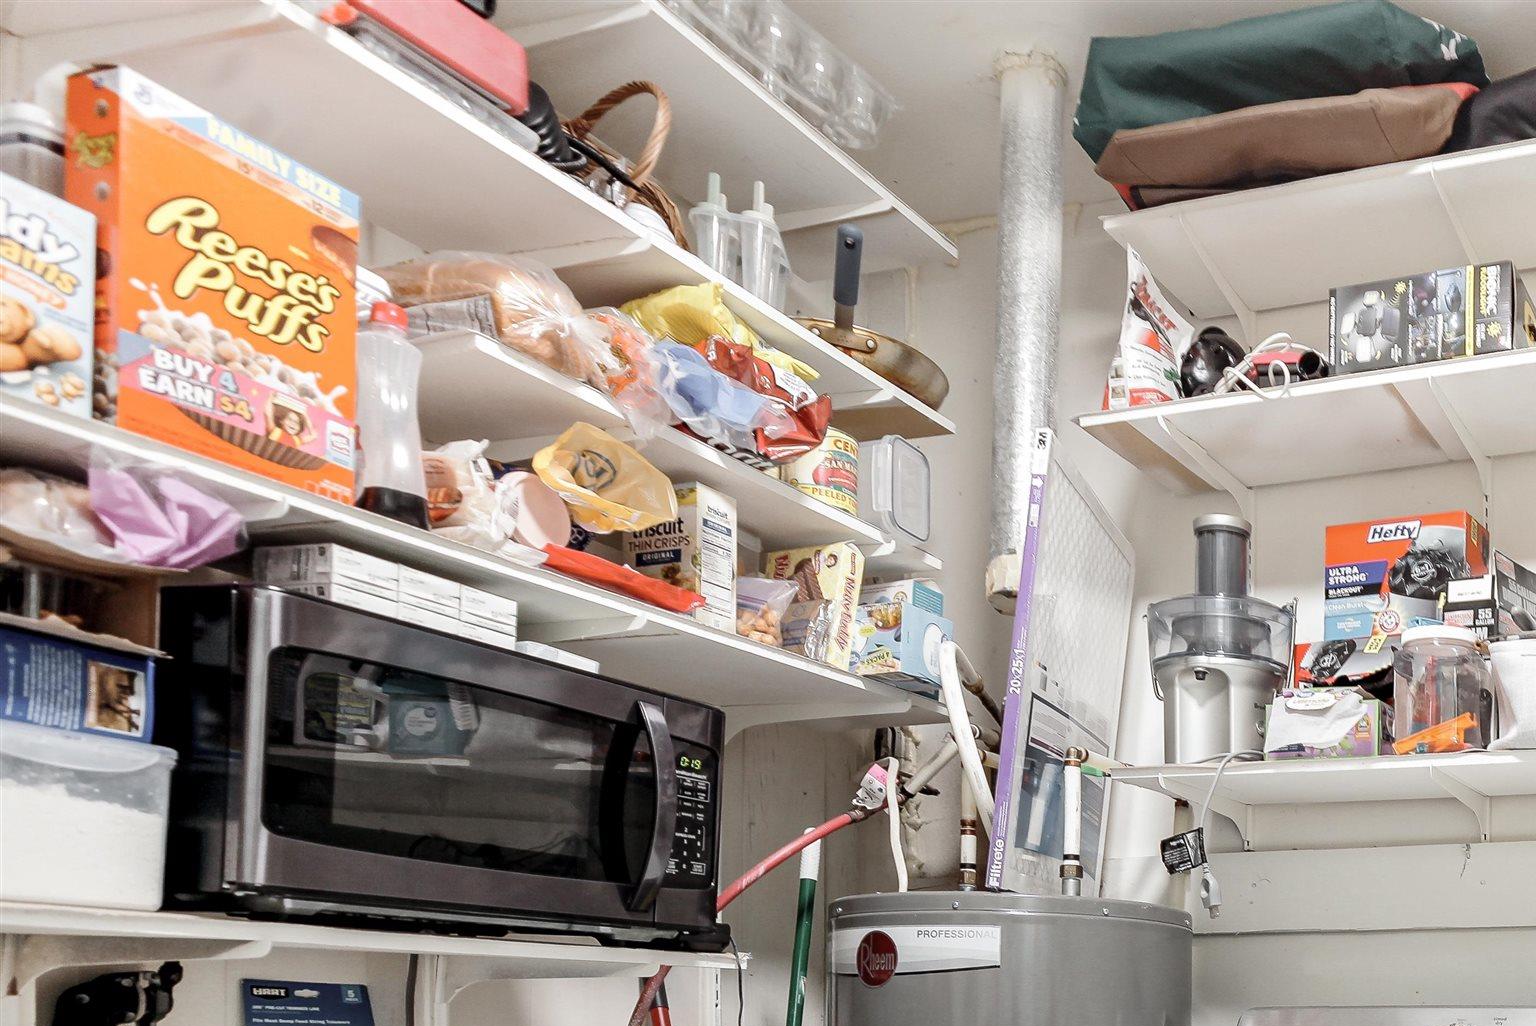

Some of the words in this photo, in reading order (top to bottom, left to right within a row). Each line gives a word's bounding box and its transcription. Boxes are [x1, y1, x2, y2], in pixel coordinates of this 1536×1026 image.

[207, 117, 292, 178] FAMILY
[295, 165, 342, 207] SIZE
[145, 196, 341, 314] Reese's
[173, 251, 330, 352] Puffs
[151, 346, 214, 383] BUY
[218, 370, 239, 394] 4
[138, 366, 216, 410] EARN
[219, 396, 254, 422] $4
[811, 487, 847, 501] PEELED
[1372, 525, 1416, 539] Hefty
[629, 540, 653, 552] THIN
[655, 535, 691, 549] CRISPS
[642, 552, 675, 561] ORIGINAL
[1328, 565, 1360, 577] ULTRA
[1328, 574, 1367, 585] STRONG
[1328, 586, 1361, 596] BLACKOUT
[1478, 609, 1492, 619] 55
[1475, 618, 1495, 626] GALLON
[1009, 648, 1027, 695] 20x25x1
[988, 838, 1005, 887] Filtrete
[916, 930, 997, 940] PROFESSIONAL
[860, 943, 895, 980] Rheem
[252, 987, 286, 997] HART
[347, 990, 355, 998] 5
